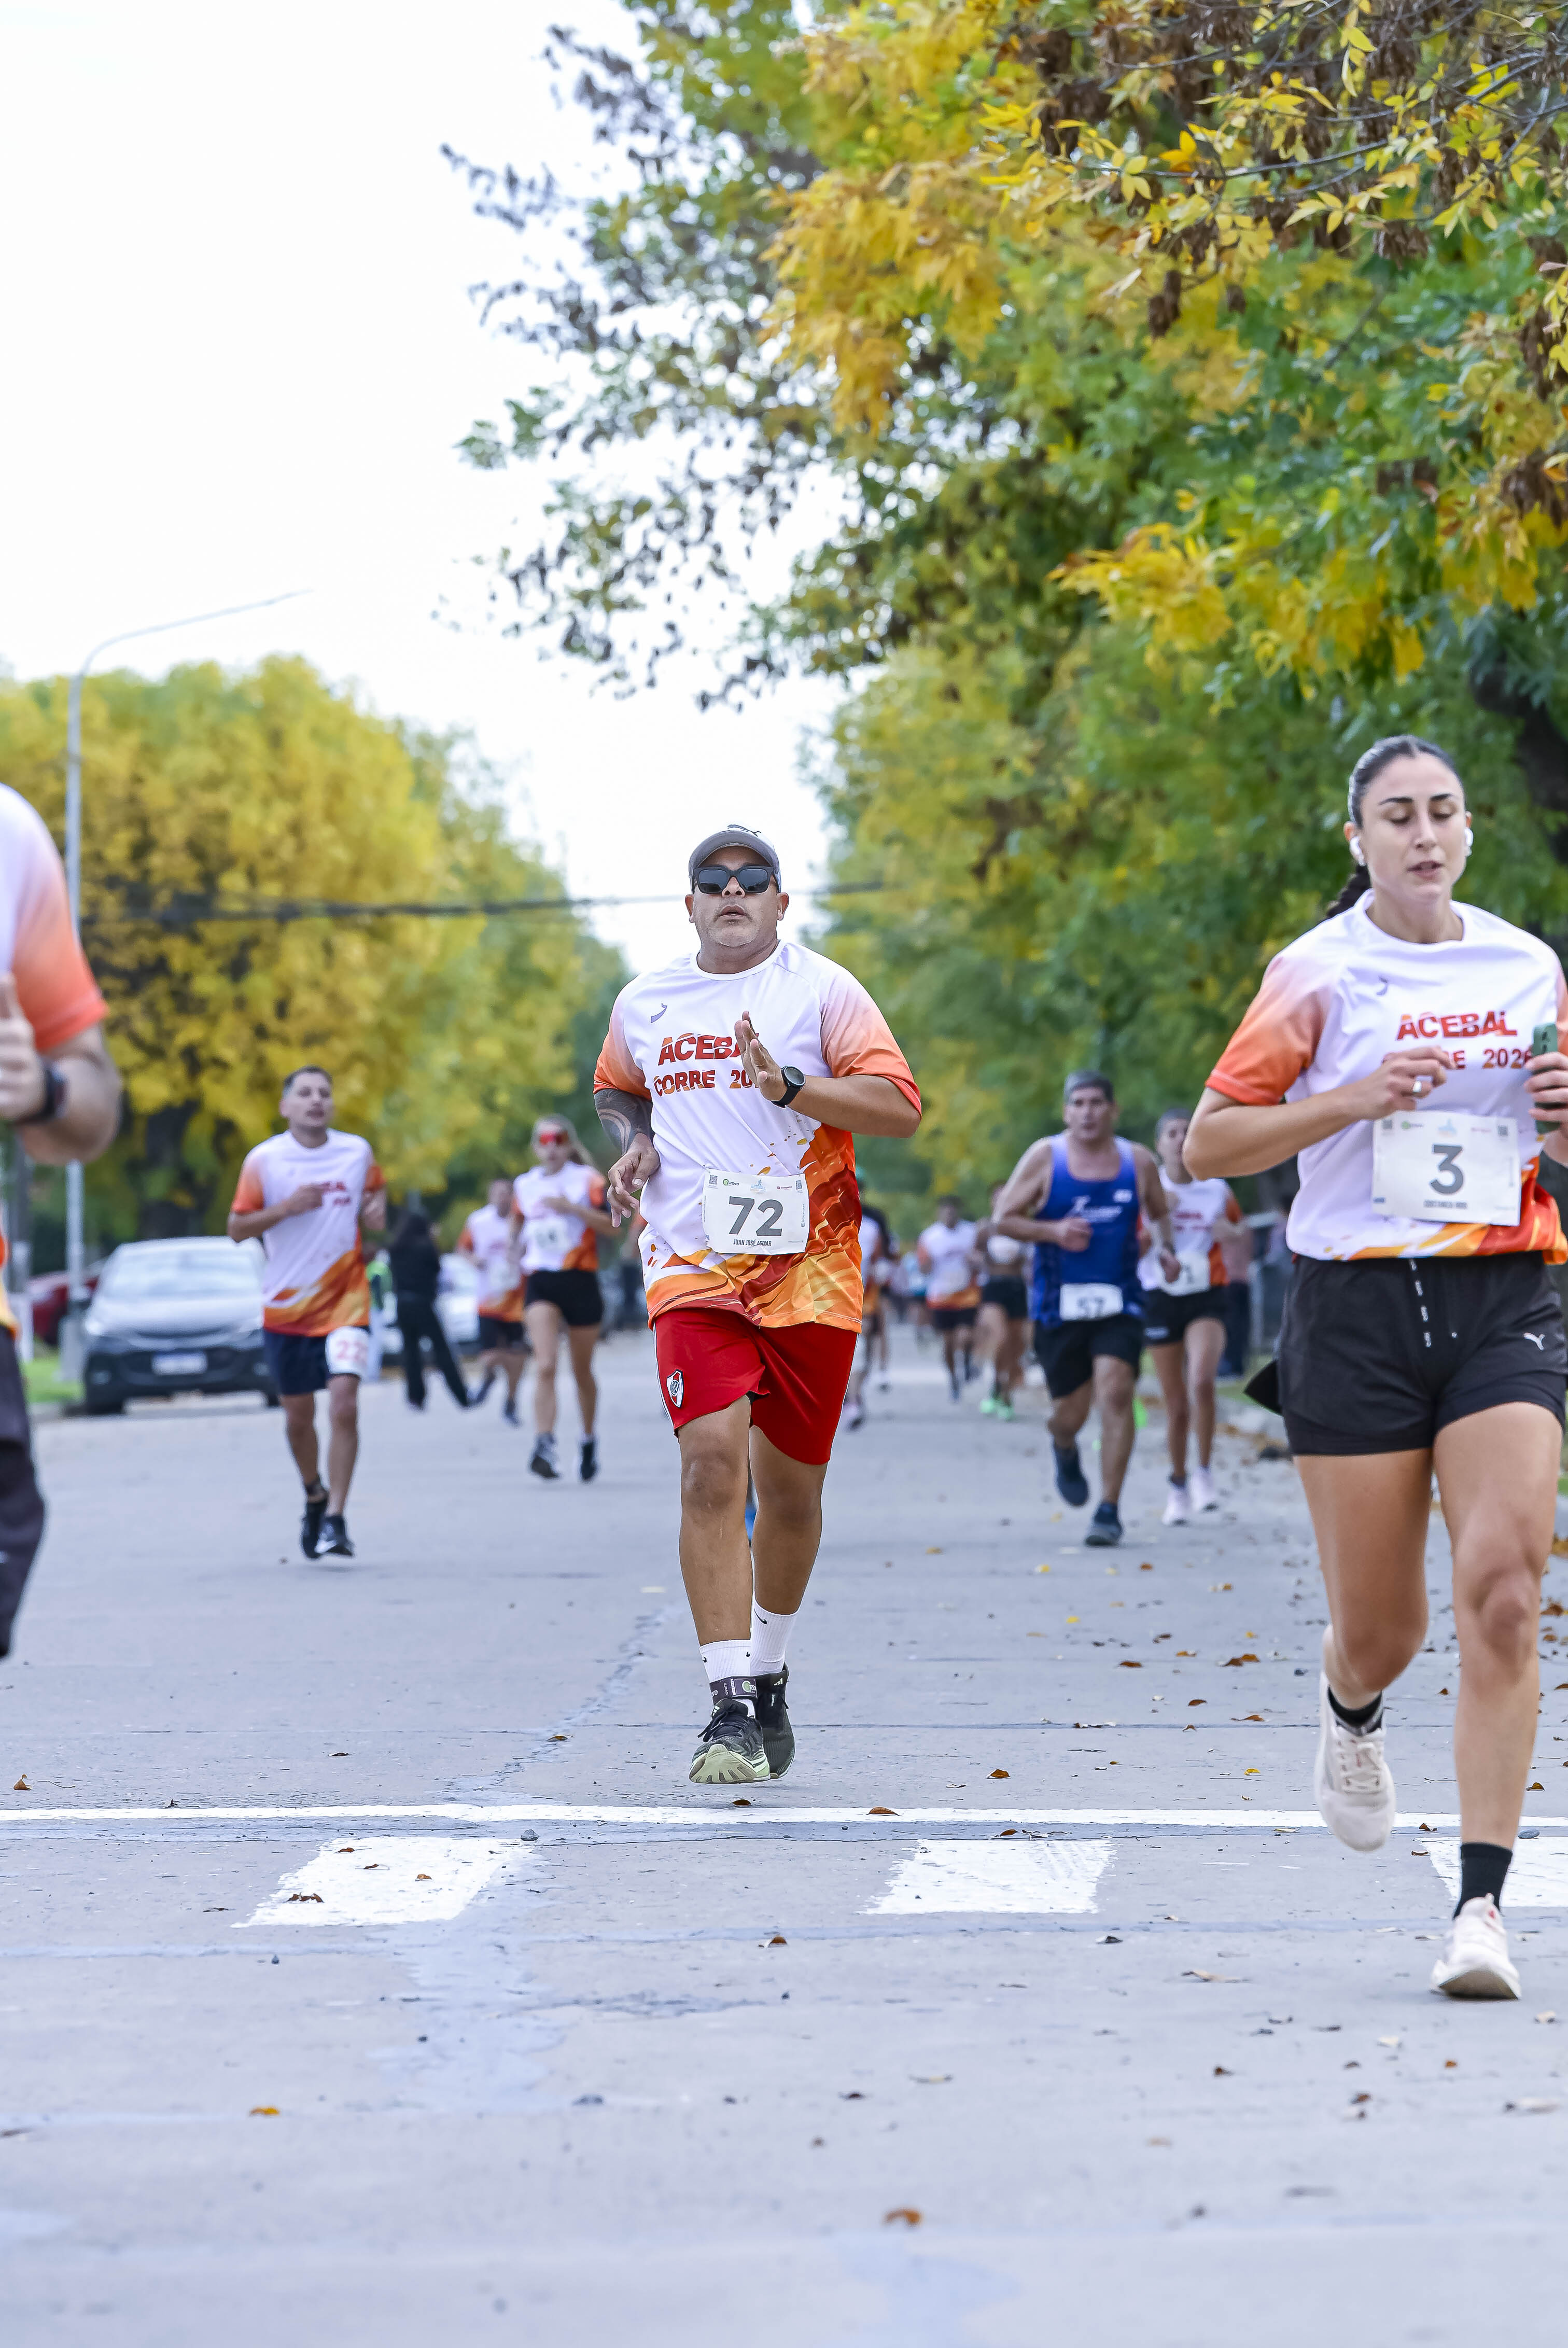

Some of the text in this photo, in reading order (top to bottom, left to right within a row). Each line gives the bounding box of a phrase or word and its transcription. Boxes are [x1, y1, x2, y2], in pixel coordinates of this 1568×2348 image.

[1396, 1010, 1518, 1041] ACEBAL
[657, 1032, 759, 1066] ACEB
[653, 1069, 760, 1097] CORRE 20
[1430, 1144, 1464, 1194] 3
[729, 1196, 783, 1236] 72
